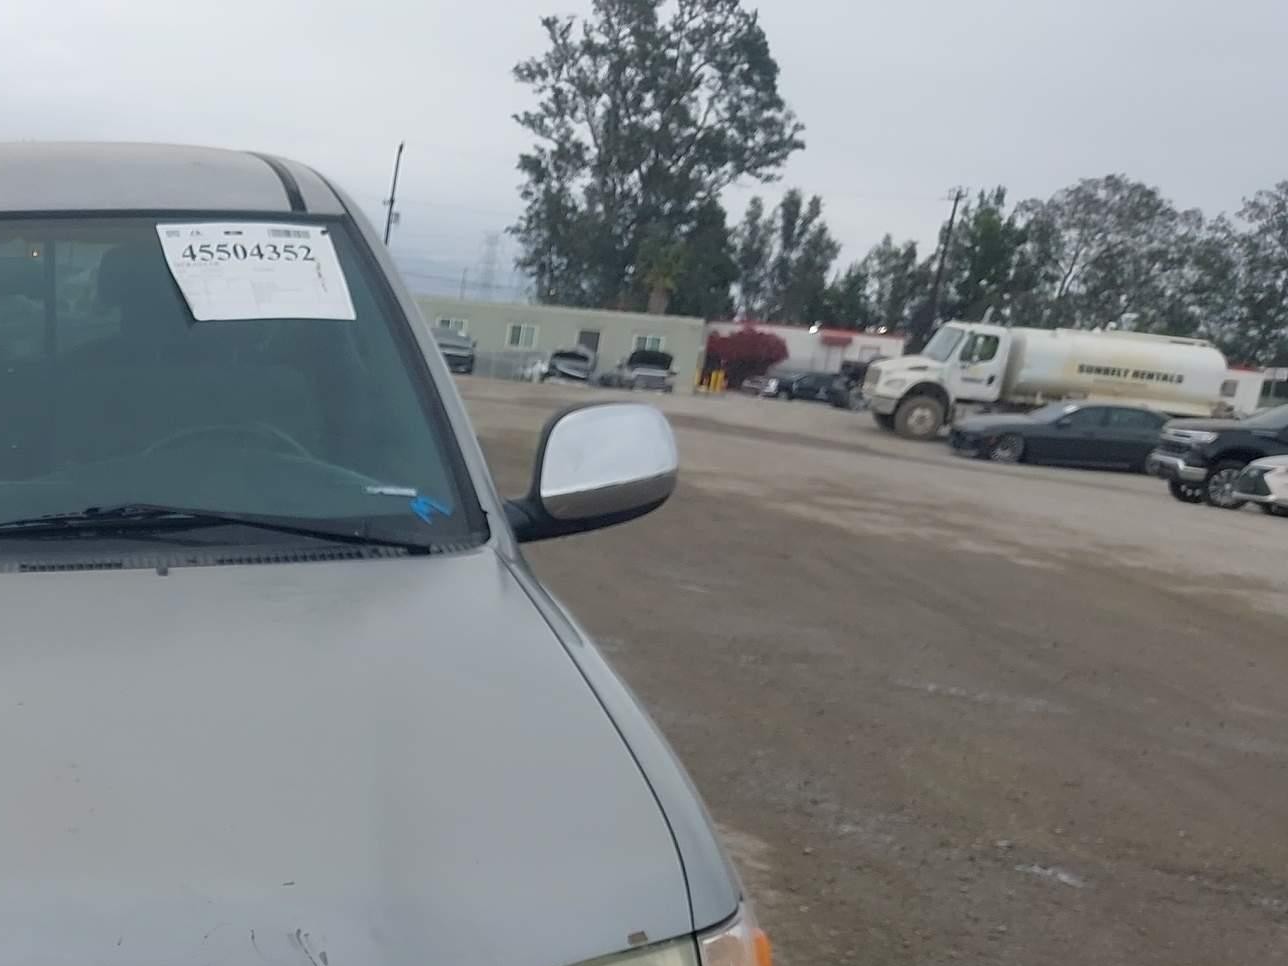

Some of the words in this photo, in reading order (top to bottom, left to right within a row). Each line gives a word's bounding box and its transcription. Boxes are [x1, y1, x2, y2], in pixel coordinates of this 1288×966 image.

[182, 243, 315, 262] 45504352
[1077, 363, 1129, 379] SUNBELT
[1132, 369, 1185, 384] RENTALS
